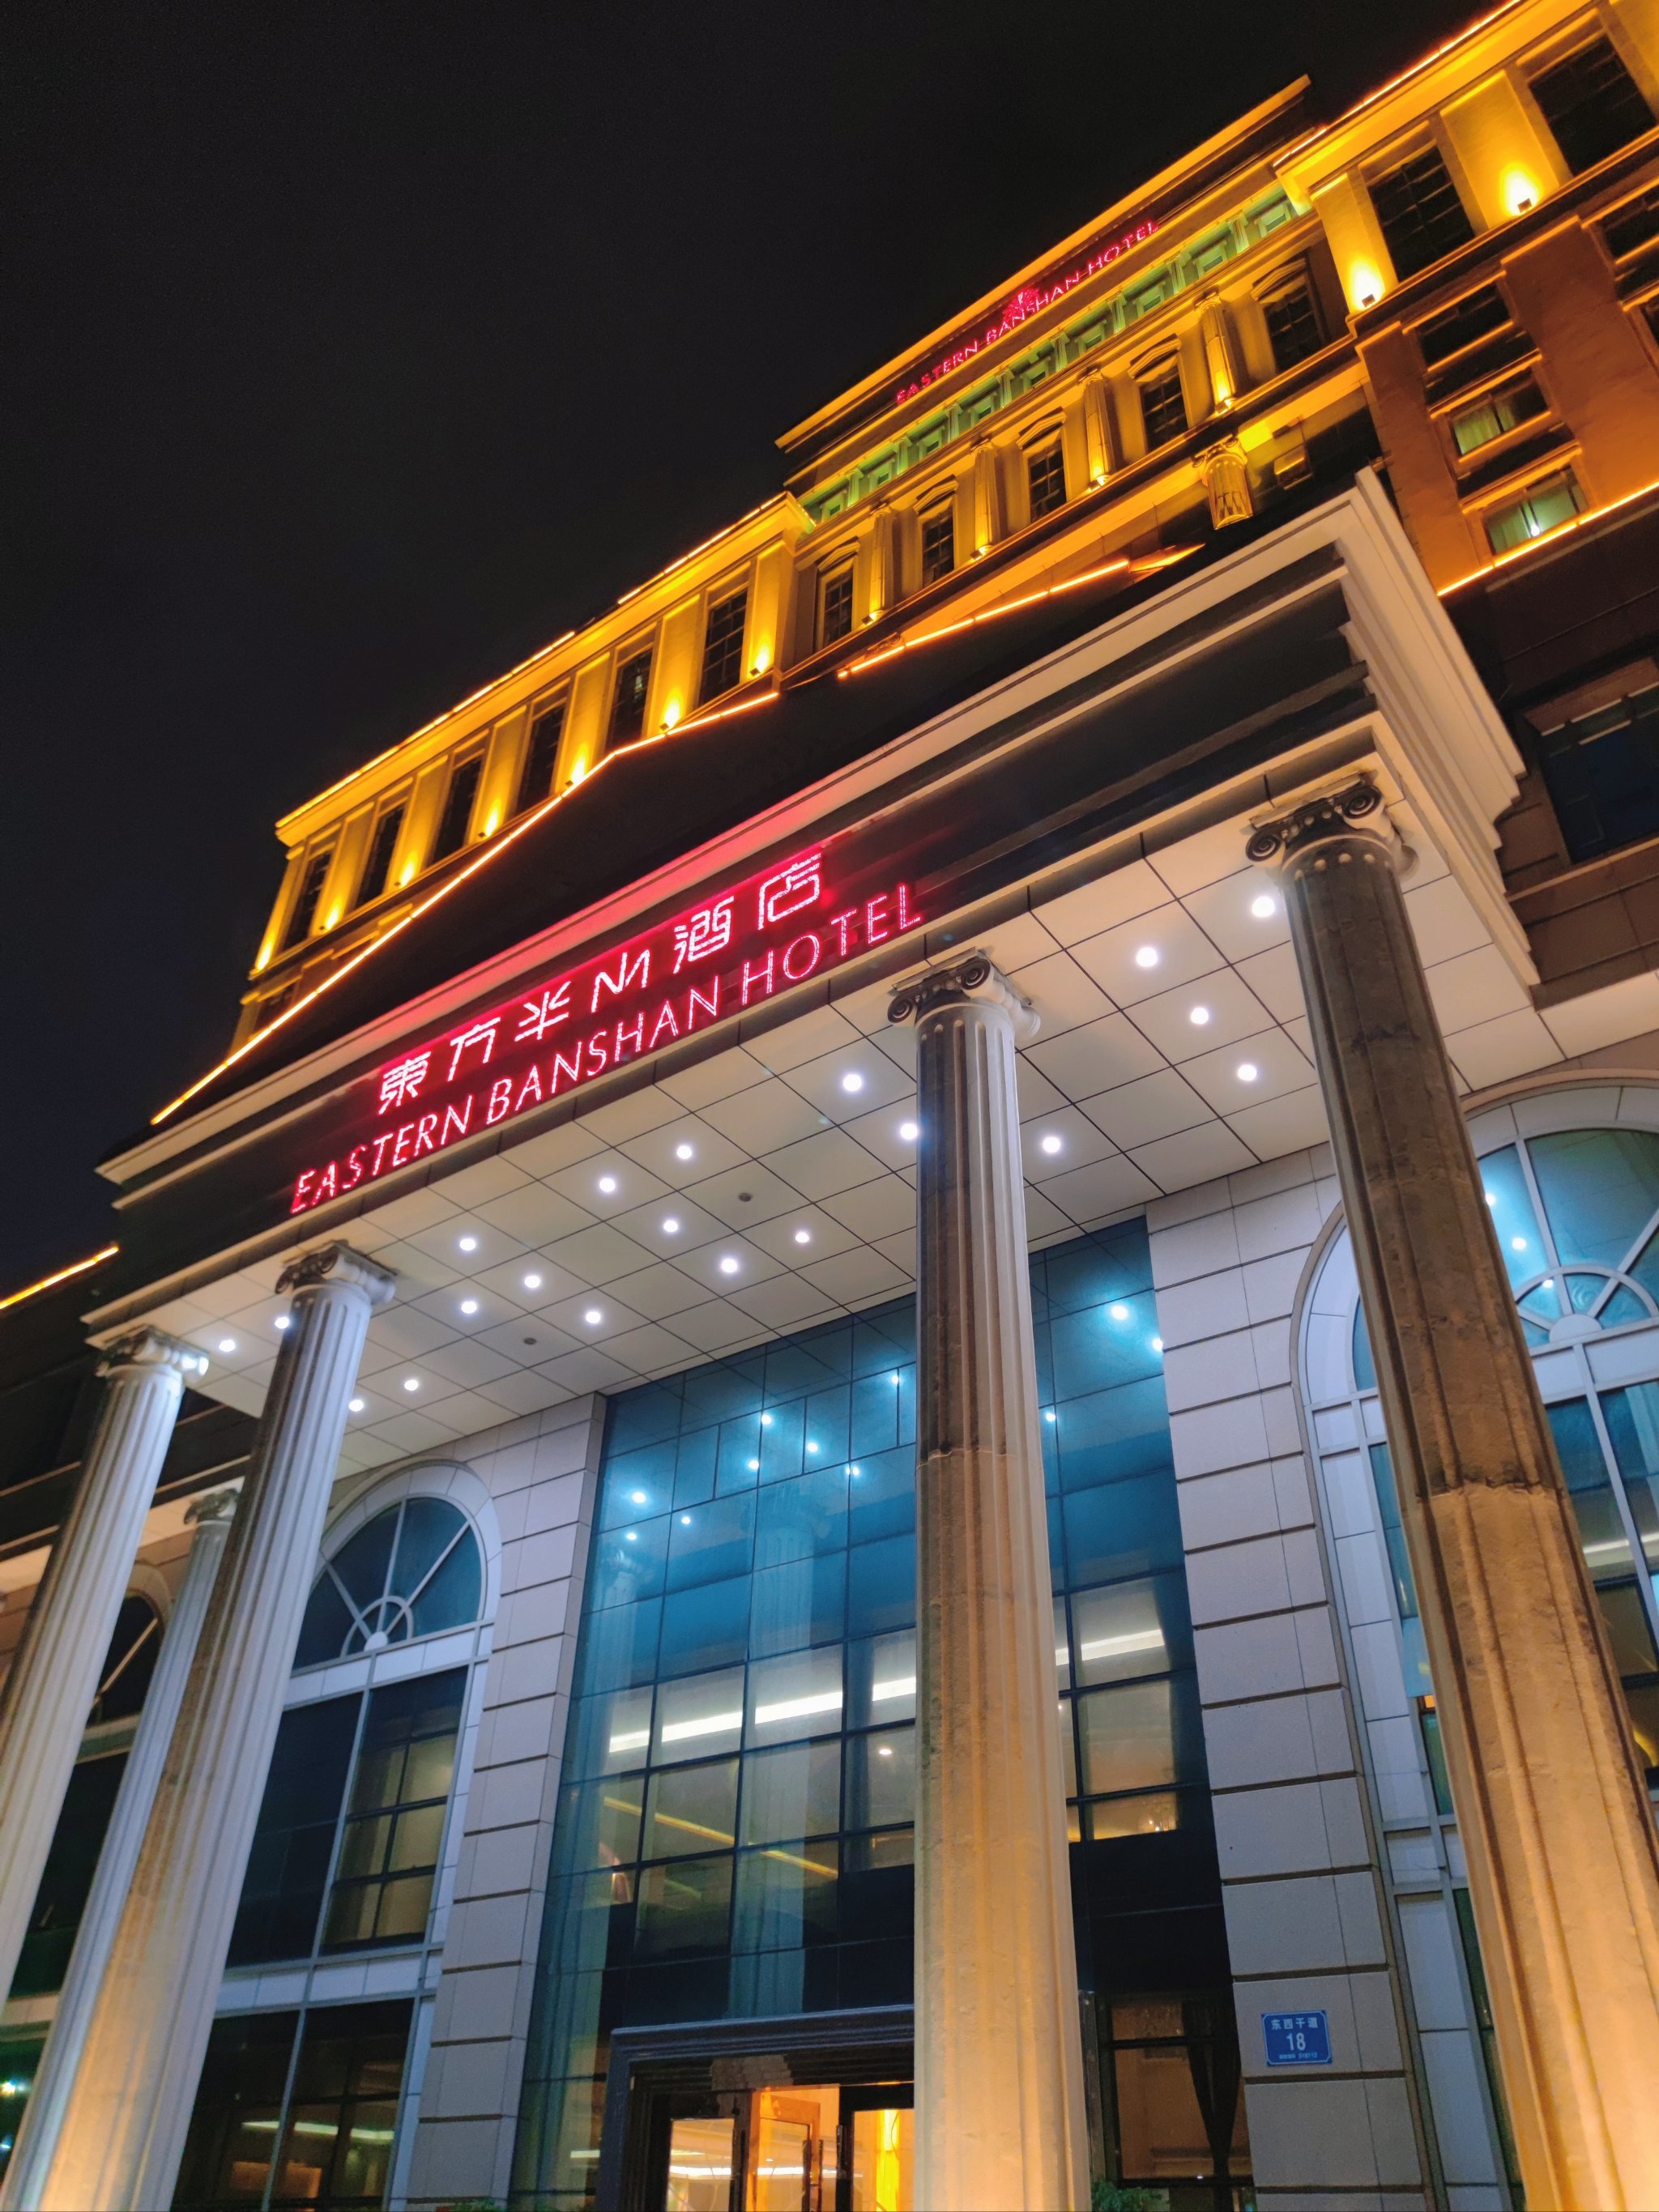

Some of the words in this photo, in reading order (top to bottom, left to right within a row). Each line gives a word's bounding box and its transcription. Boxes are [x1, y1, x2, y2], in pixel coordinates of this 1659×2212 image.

[896, 338, 979, 405] EASTERN
[986, 272, 1080, 345] BANSHAN
[1088, 222, 1158, 275] HOTEL
[290, 1094, 474, 1214] EASTERN
[485, 974, 720, 1125] BANSHAN
[741, 884, 923, 1006] HOTEL
[1271, 2017, 1318, 2030] 东西干道
[1286, 2032, 1306, 2051] 18
